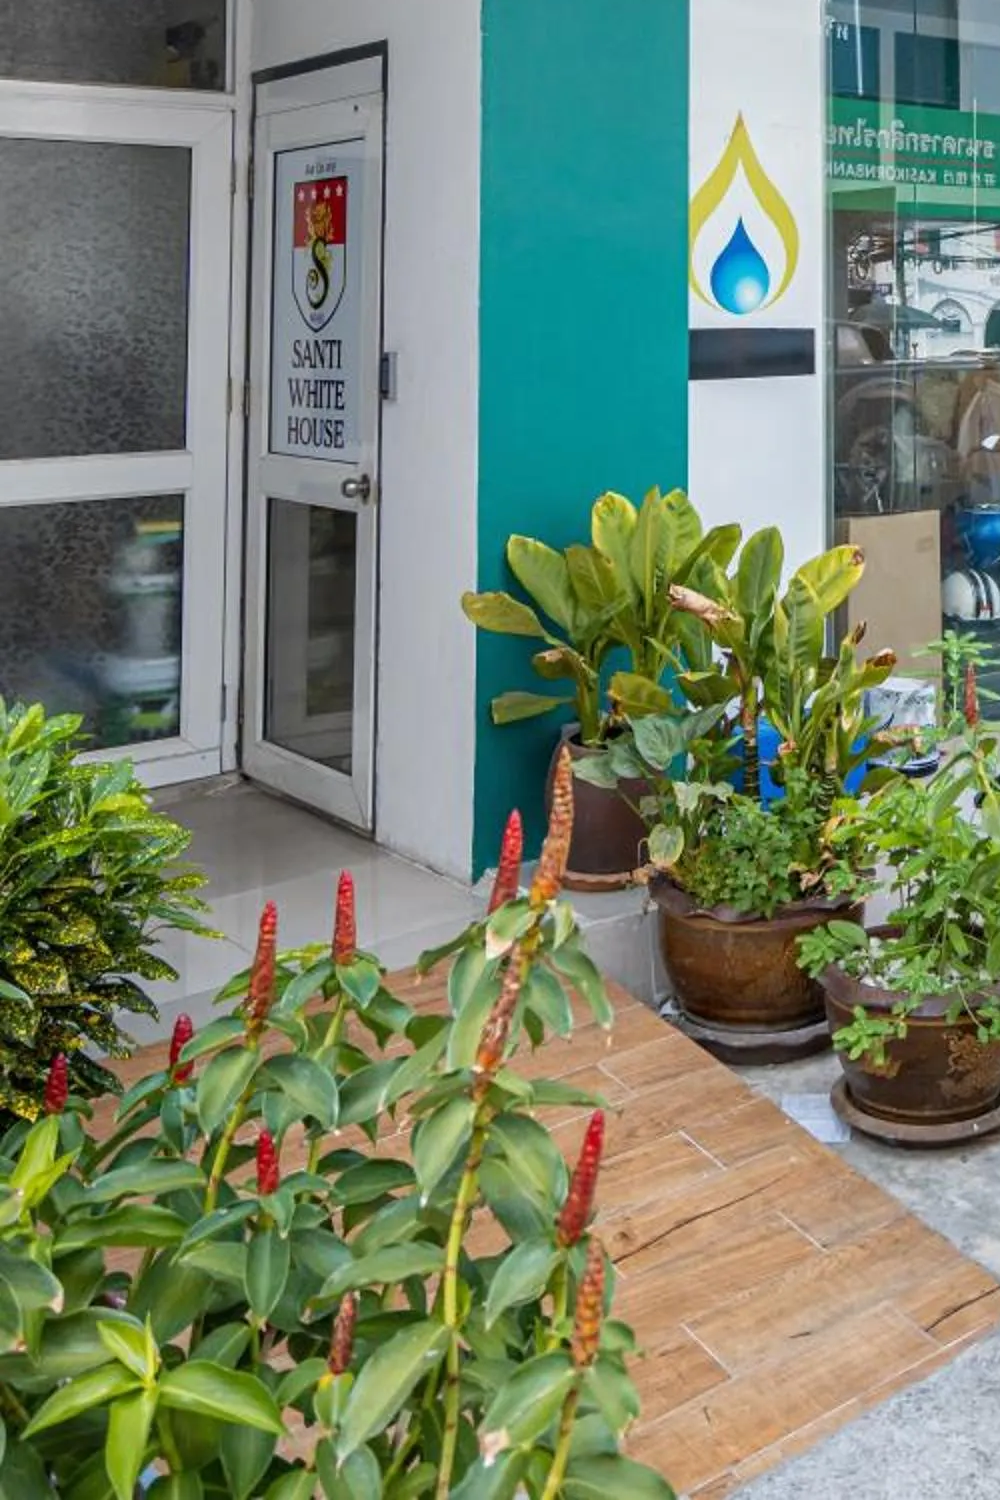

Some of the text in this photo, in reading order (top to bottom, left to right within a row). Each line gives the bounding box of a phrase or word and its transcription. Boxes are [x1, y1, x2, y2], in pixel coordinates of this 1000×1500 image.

[292, 339, 342, 369] SANTI
[288, 378, 345, 410] WHITE
[287, 416, 345, 448] HOUSE
